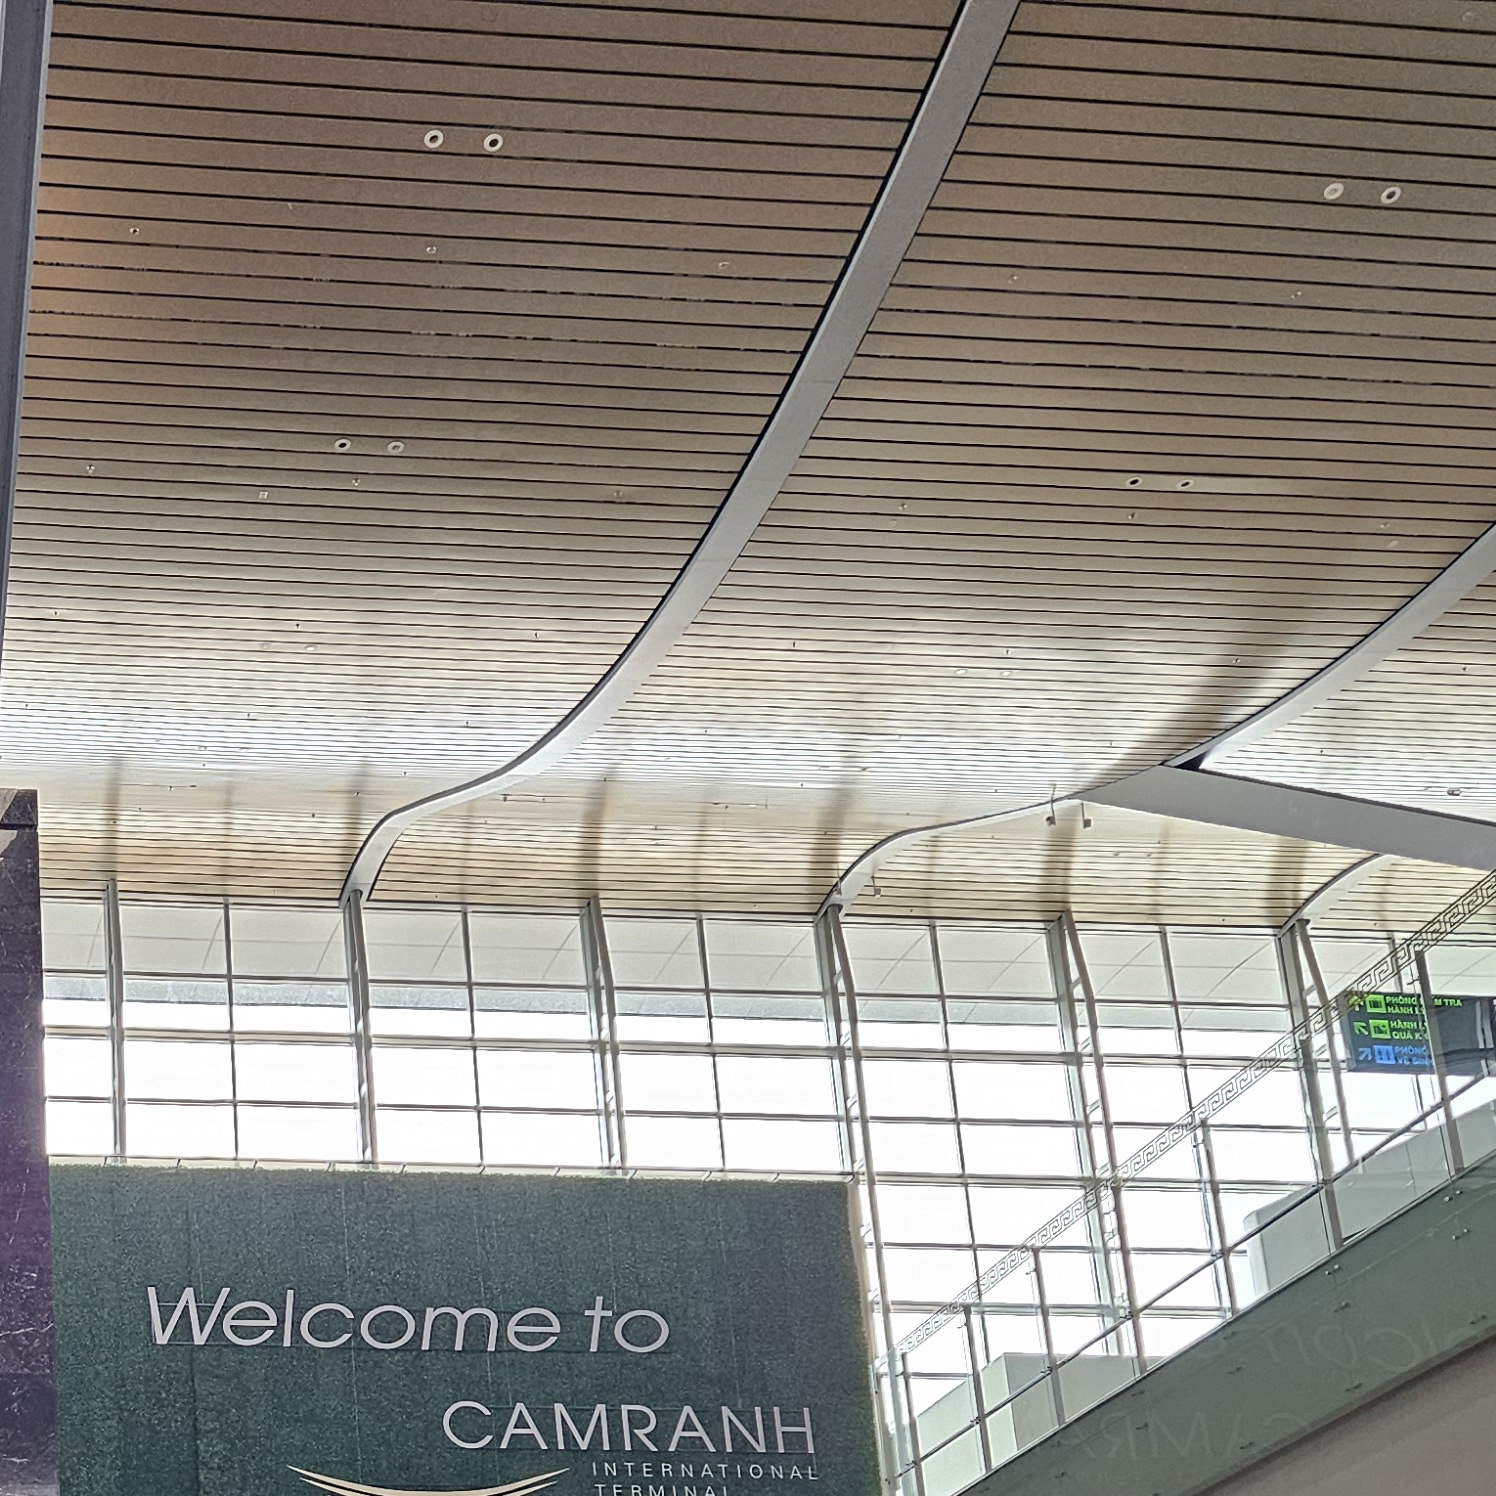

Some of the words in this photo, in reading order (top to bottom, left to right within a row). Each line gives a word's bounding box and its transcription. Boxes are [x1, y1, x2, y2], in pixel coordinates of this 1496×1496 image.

[146, 1286, 561, 1352] Welcome
[584, 1295, 670, 1353] to
[442, 1400, 816, 1454] CAMRANH
[592, 1461, 818, 1481] INTERNATIONAL
